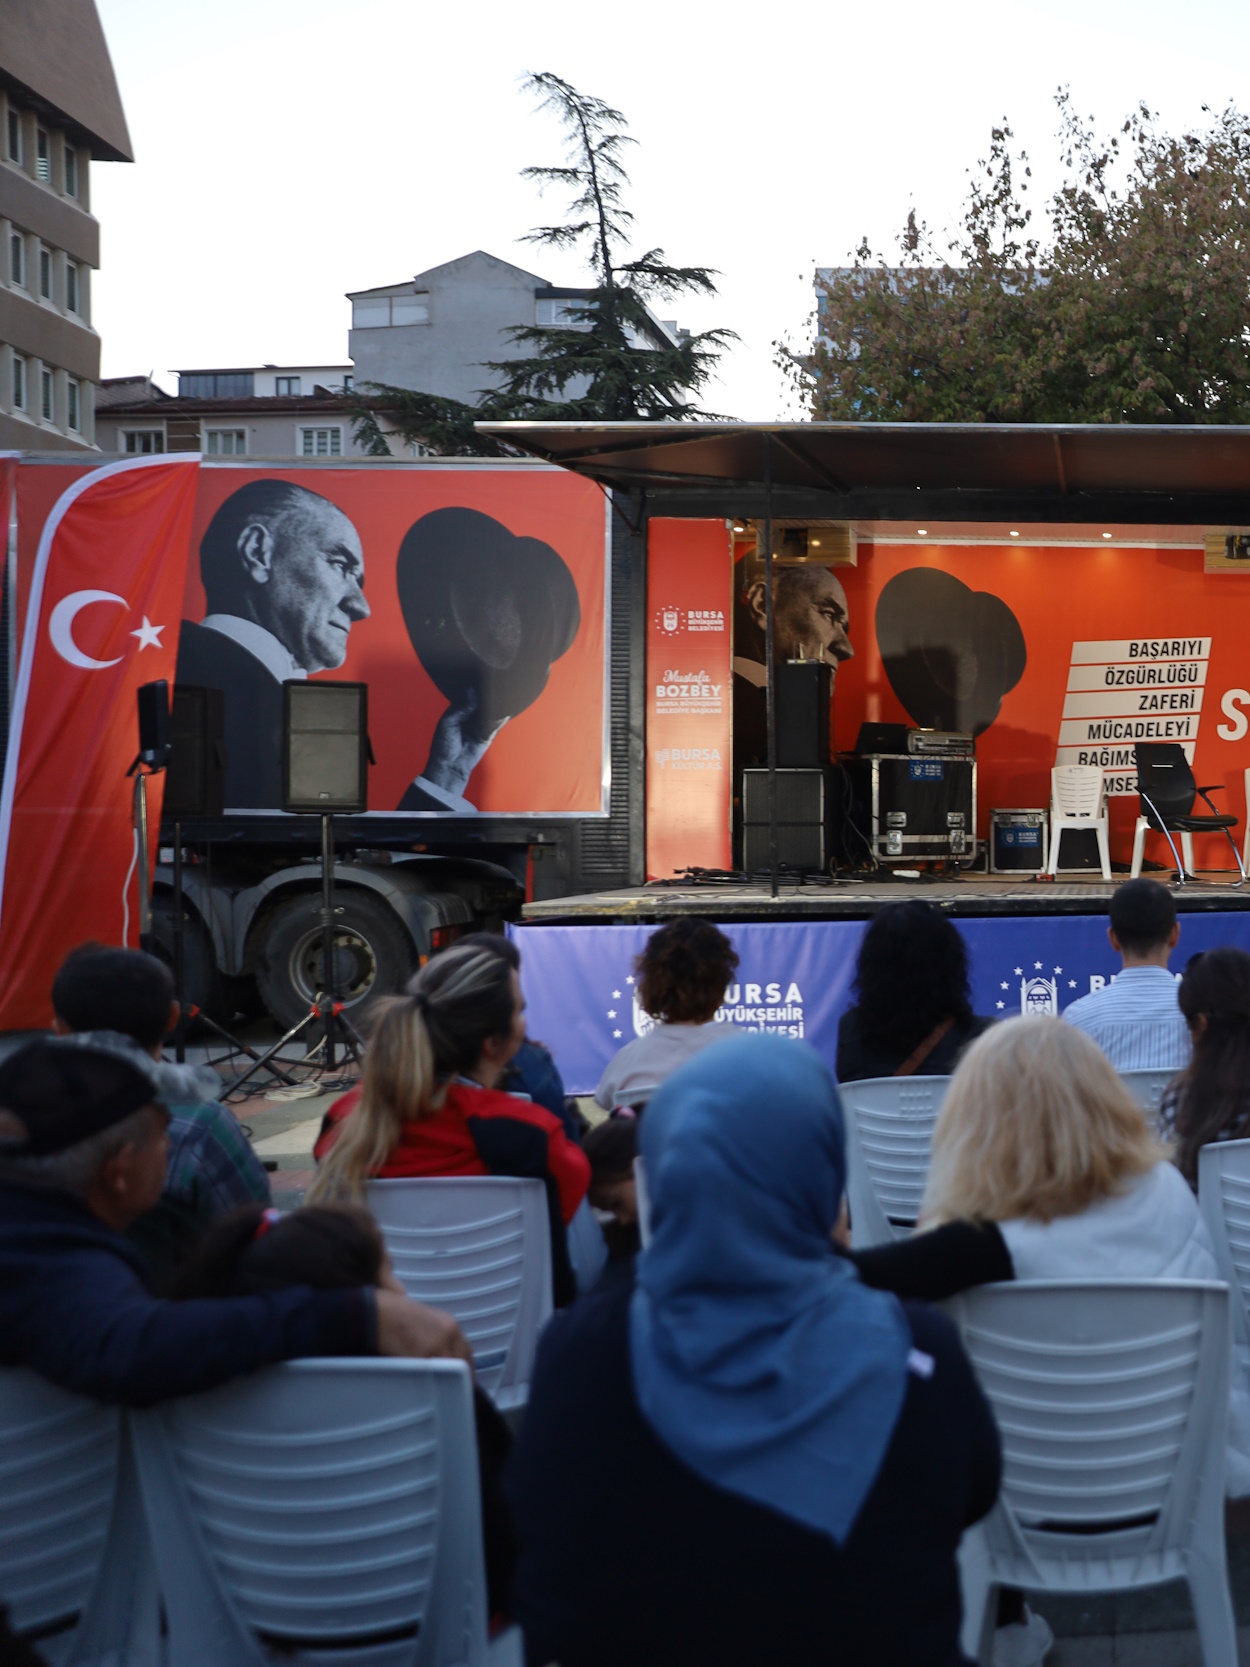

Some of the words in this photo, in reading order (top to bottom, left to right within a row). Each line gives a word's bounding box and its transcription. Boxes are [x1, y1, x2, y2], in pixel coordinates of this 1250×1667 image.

[688, 611, 724, 619] BURSA
[1129, 640, 1202, 660] BAŞARIYI
[662, 669, 711, 686] Mustafa
[1105, 663, 1198, 685] ÖZGÜRLÜĞÜ
[656, 685, 721, 697] BOZBEY
[1138, 689, 1195, 711] ZAFERİ
[1087, 717, 1190, 740] MÜCADELEYİ
[672, 748, 721, 760] BURSA
[672, 760, 705, 769] KÜLTÜR
[724, 982, 804, 1004] URSA
[713, 1003, 804, 1024] ÜYÜKŞEHİR
[741, 1021, 804, 1039] DİYESİ
